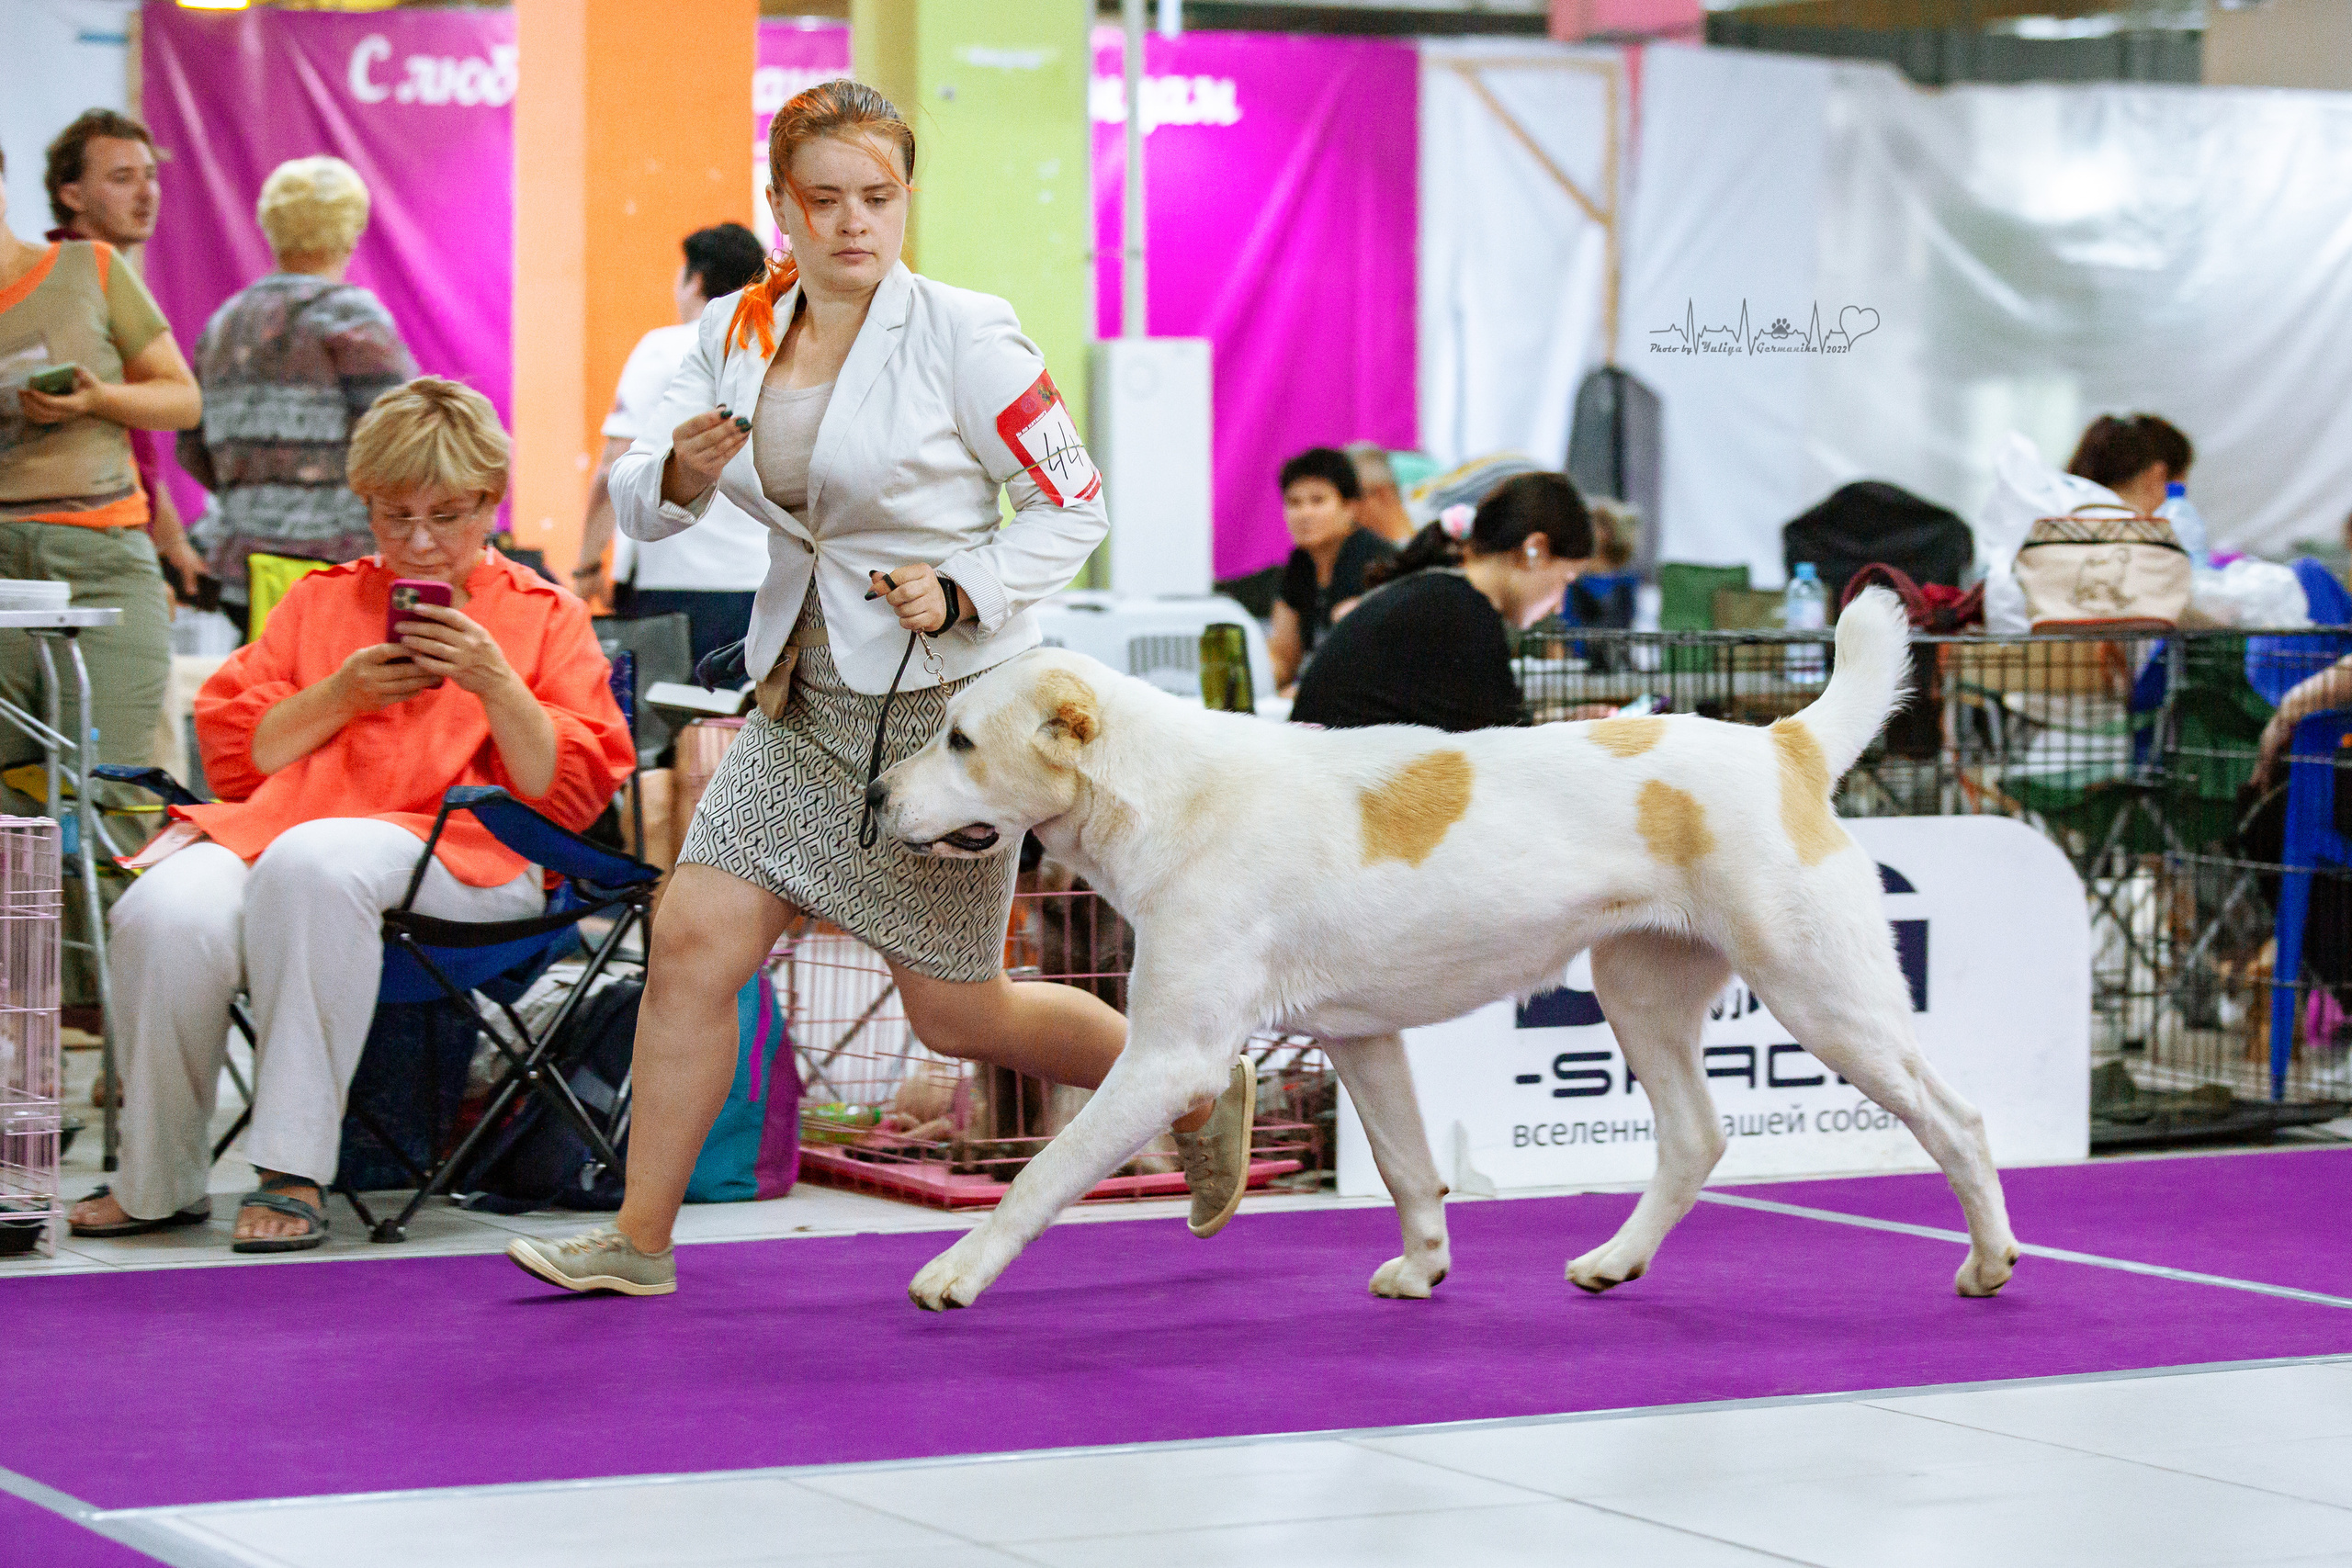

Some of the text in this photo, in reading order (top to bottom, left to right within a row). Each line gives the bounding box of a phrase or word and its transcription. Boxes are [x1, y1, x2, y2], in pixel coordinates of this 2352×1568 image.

[349, 34, 391, 104] С
[395, 43, 519, 107] люб
[1043, 421, 1084, 480] 44
[1513, 1119, 1657, 1148] вселенн
[1721, 1104, 1806, 1137] ашей
